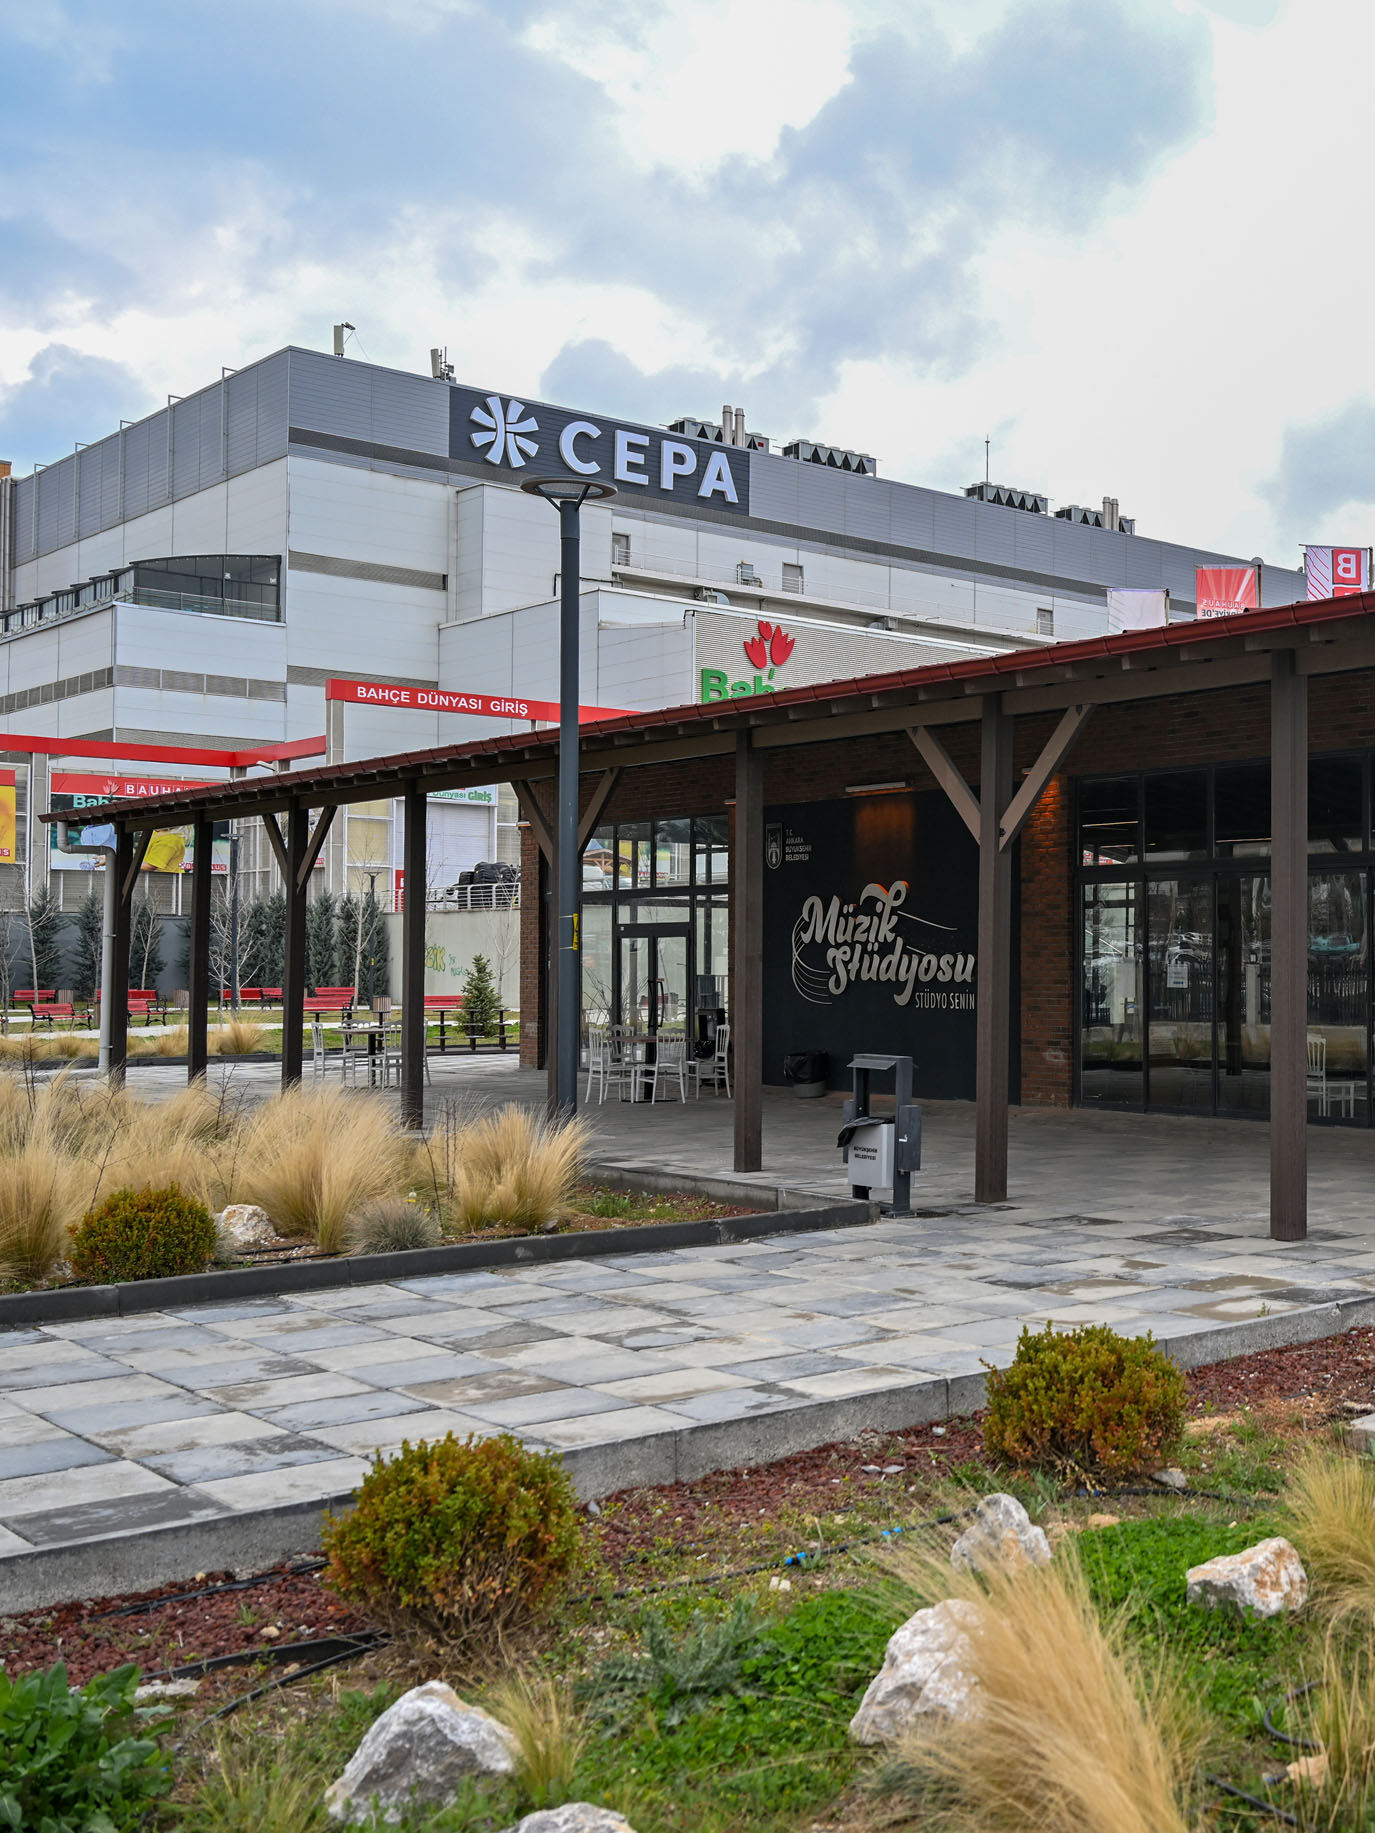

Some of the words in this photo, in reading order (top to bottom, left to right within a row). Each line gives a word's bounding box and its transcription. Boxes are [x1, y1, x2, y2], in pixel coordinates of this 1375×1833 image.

[559, 420, 739, 504] CEPA
[357, 686, 410, 705] BAHÇE
[417, 692, 482, 710] DÜNYASI
[490, 699, 529, 716] GİRİŞ
[701, 668, 788, 704] Bah
[800, 881, 907, 945] Müzik
[826, 937, 975, 1006] Stüdyosu
[915, 989, 948, 1009] STÜDYO
[950, 989, 975, 1010] SENİN
